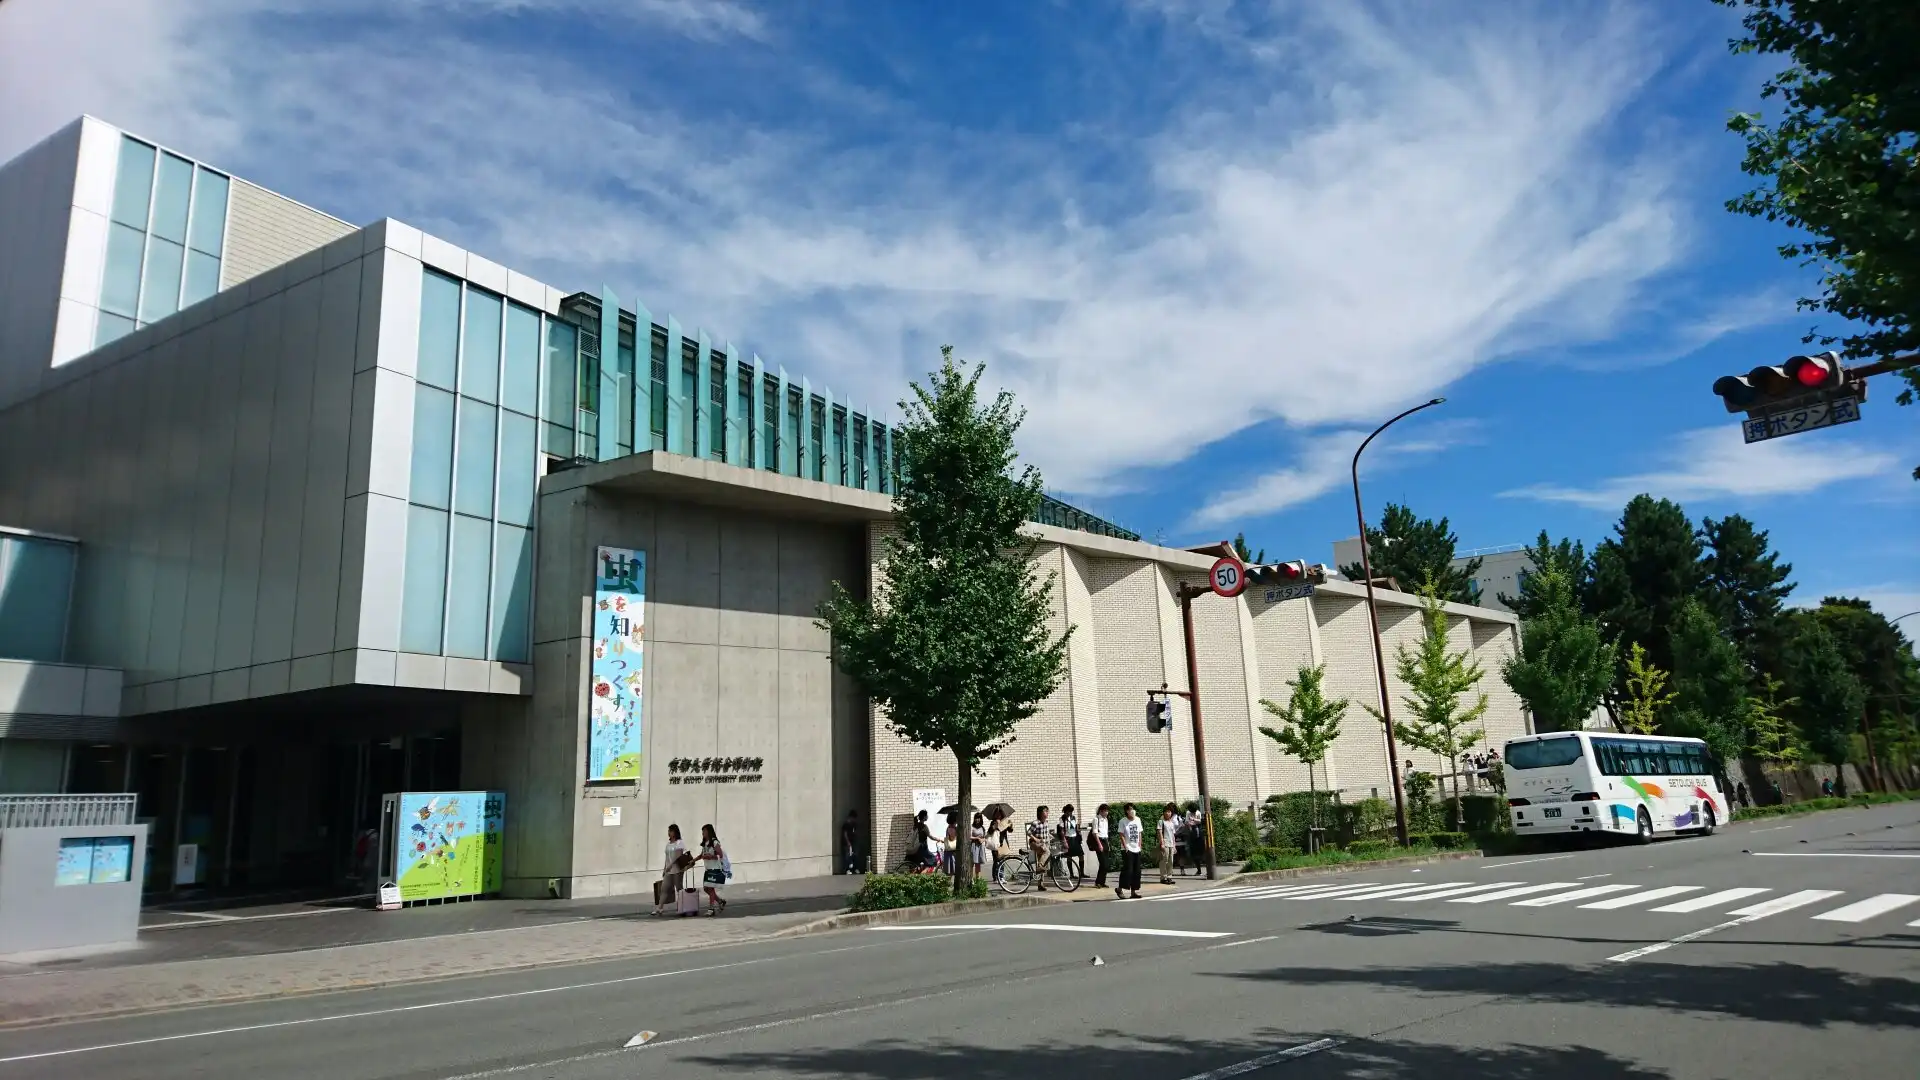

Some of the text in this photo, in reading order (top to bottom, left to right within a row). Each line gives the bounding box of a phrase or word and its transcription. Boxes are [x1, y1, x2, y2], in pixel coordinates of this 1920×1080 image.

[1749, 402, 1854, 439] 押ボタン式
[1217, 567, 1237, 587] 50
[1266, 584, 1313, 601] 押ボタン式
[602, 553, 640, 712] 虫を知りつくす
[1696, 778, 1708, 787] BUS
